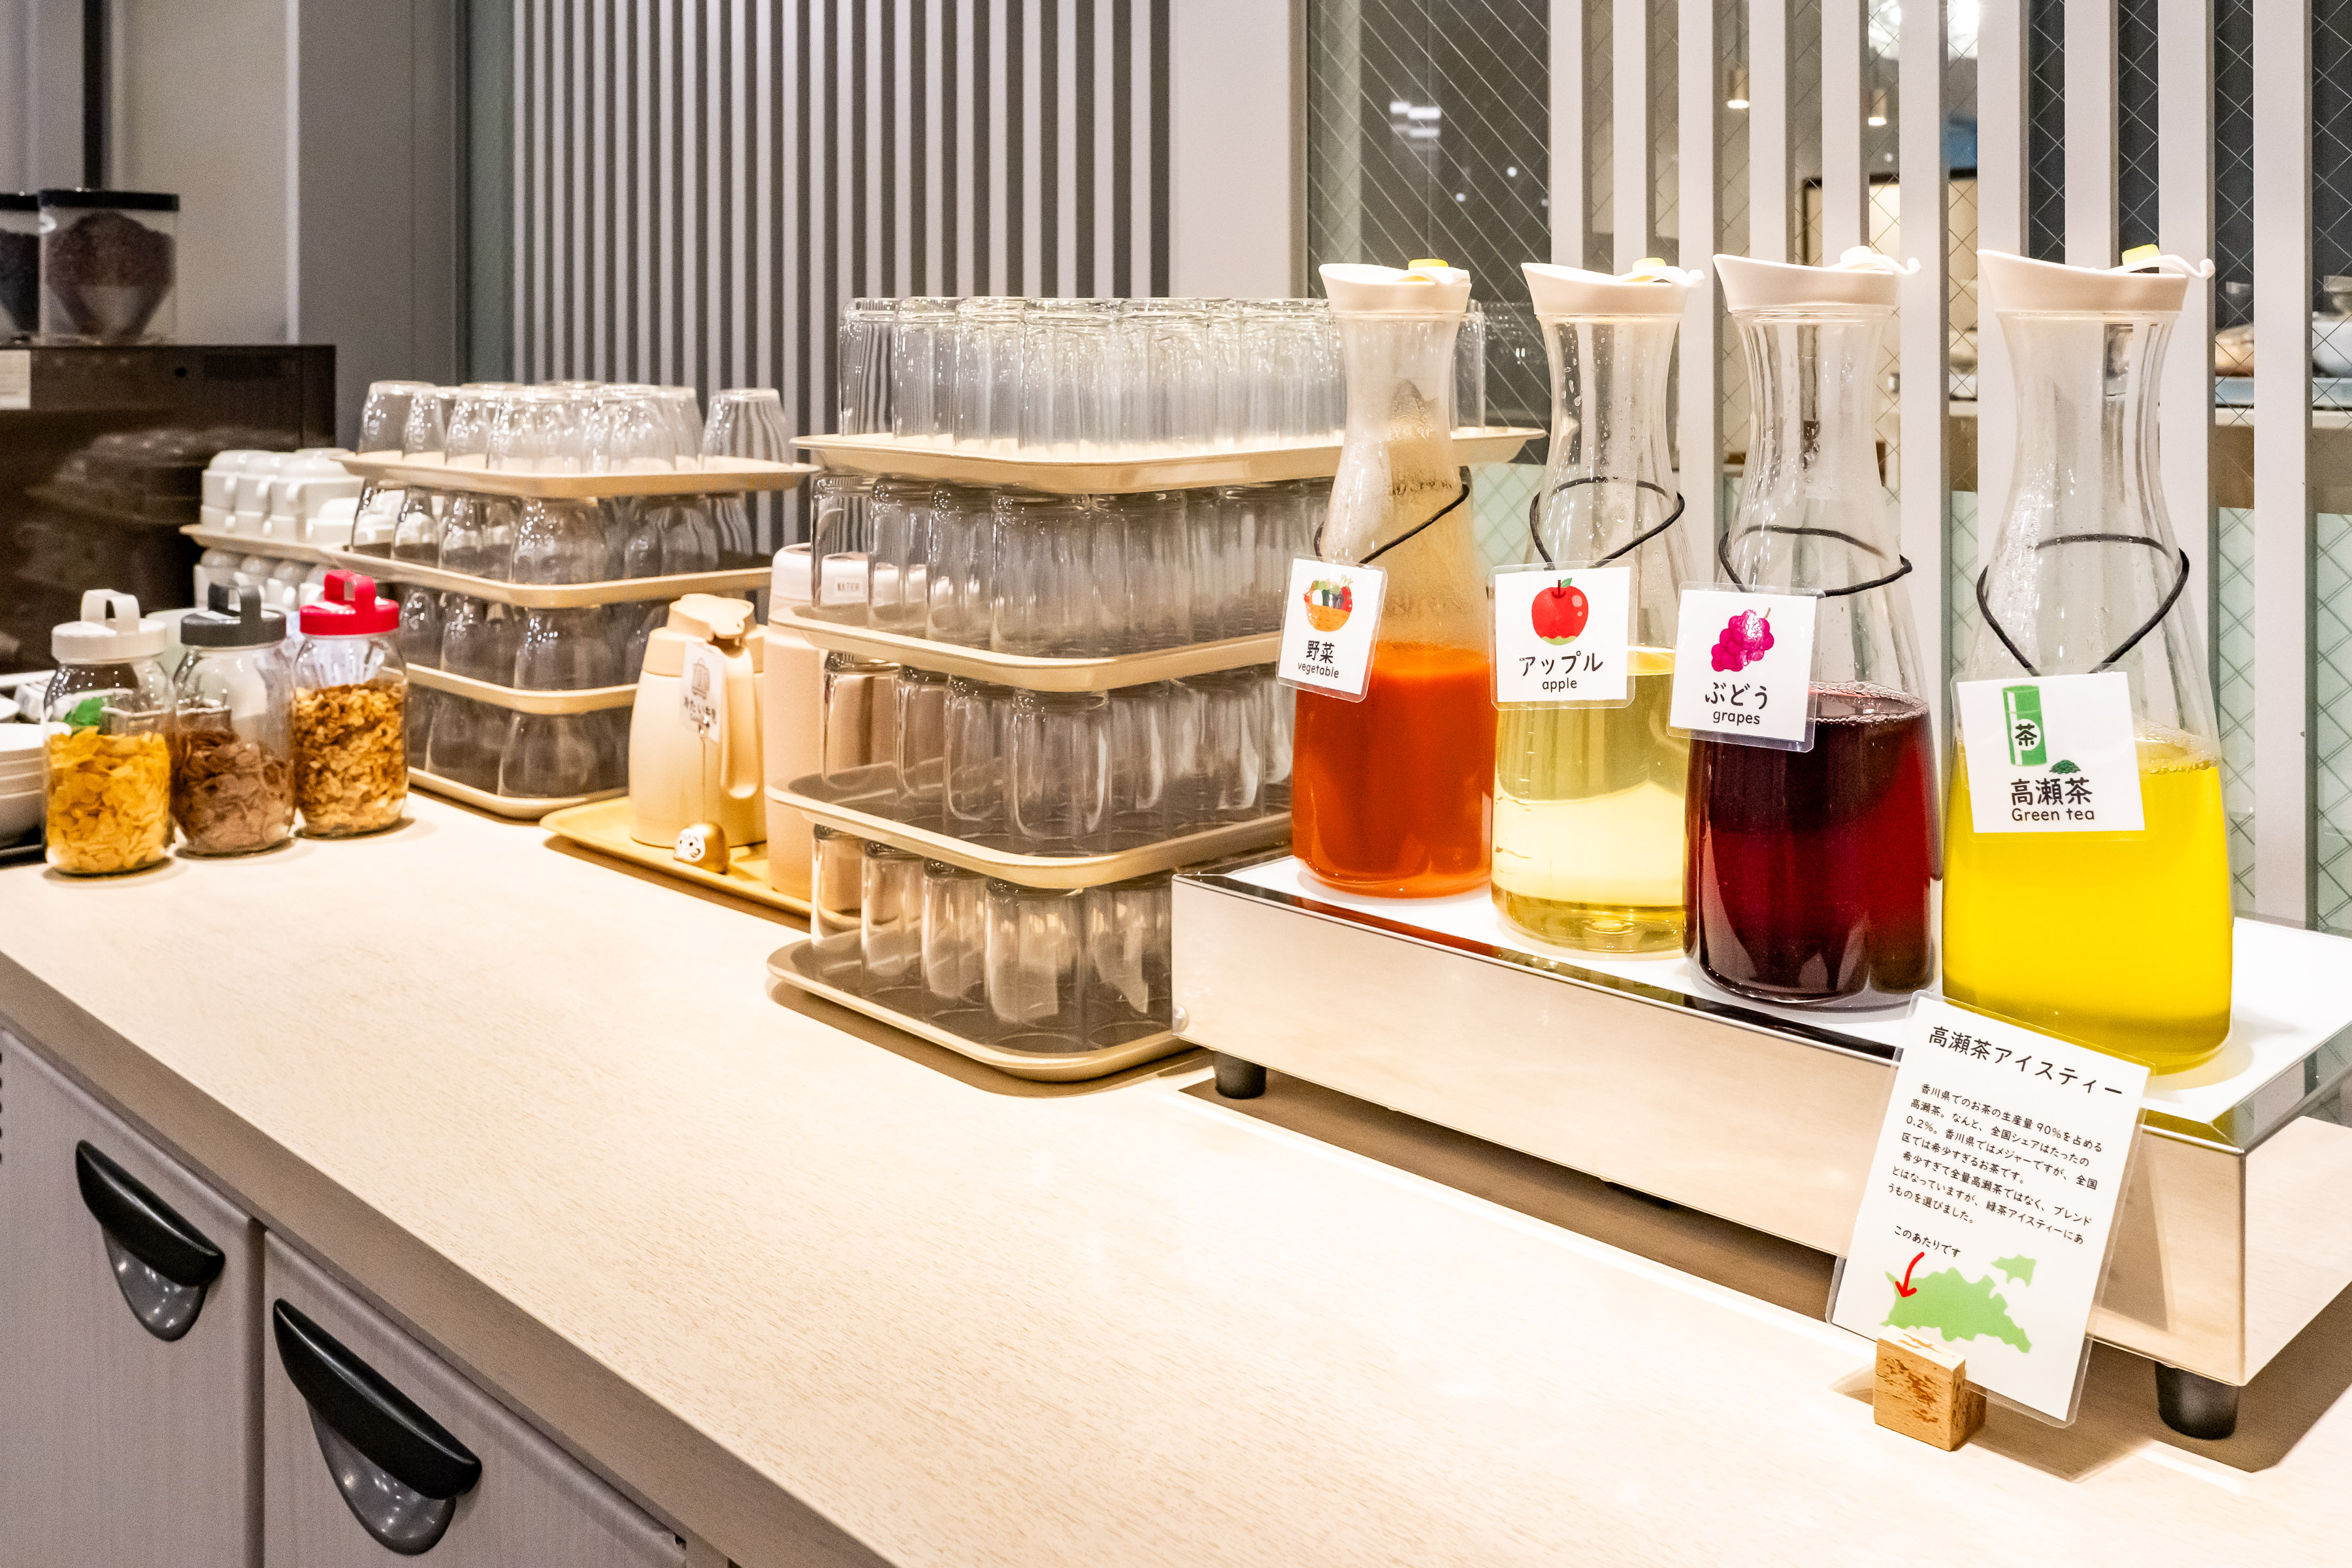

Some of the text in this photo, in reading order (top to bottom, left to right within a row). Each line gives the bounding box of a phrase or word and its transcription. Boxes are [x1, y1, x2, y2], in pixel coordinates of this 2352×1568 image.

[1305, 640, 1335, 664] 野菜
[1519, 651, 1603, 677] アップル
[1298, 661, 1339, 678] vegetable
[1541, 678, 1578, 693] apple
[1705, 681, 1769, 710] ぶどう
[1712, 710, 1761, 728] grapes
[2014, 723, 2039, 747] 茶
[2010, 776, 2093, 808] 高瀬茶
[2012, 808, 2095, 823] Green tea
[1929, 1026, 2123, 1096] 高瀬茶アイスティー
[1894, 1226, 1961, 1258] このあたりです
